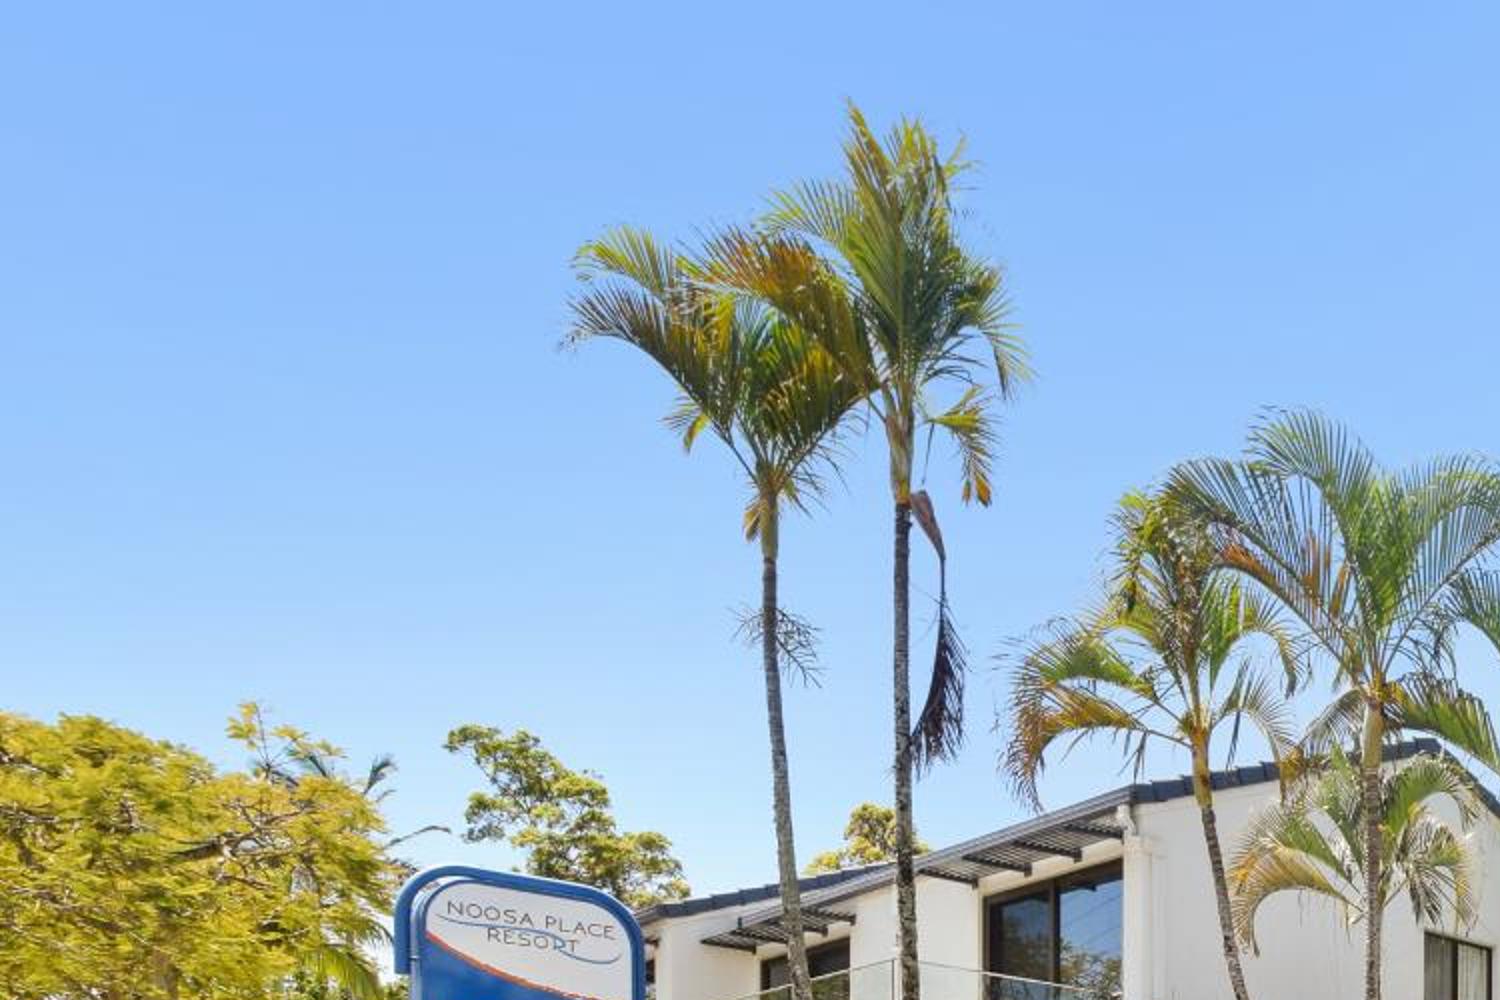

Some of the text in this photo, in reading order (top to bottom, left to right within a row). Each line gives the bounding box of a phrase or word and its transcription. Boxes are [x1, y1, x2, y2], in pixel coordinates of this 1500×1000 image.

[446, 901, 617, 941] NOOSA PLACE
[487, 928, 580, 953] RESORT
